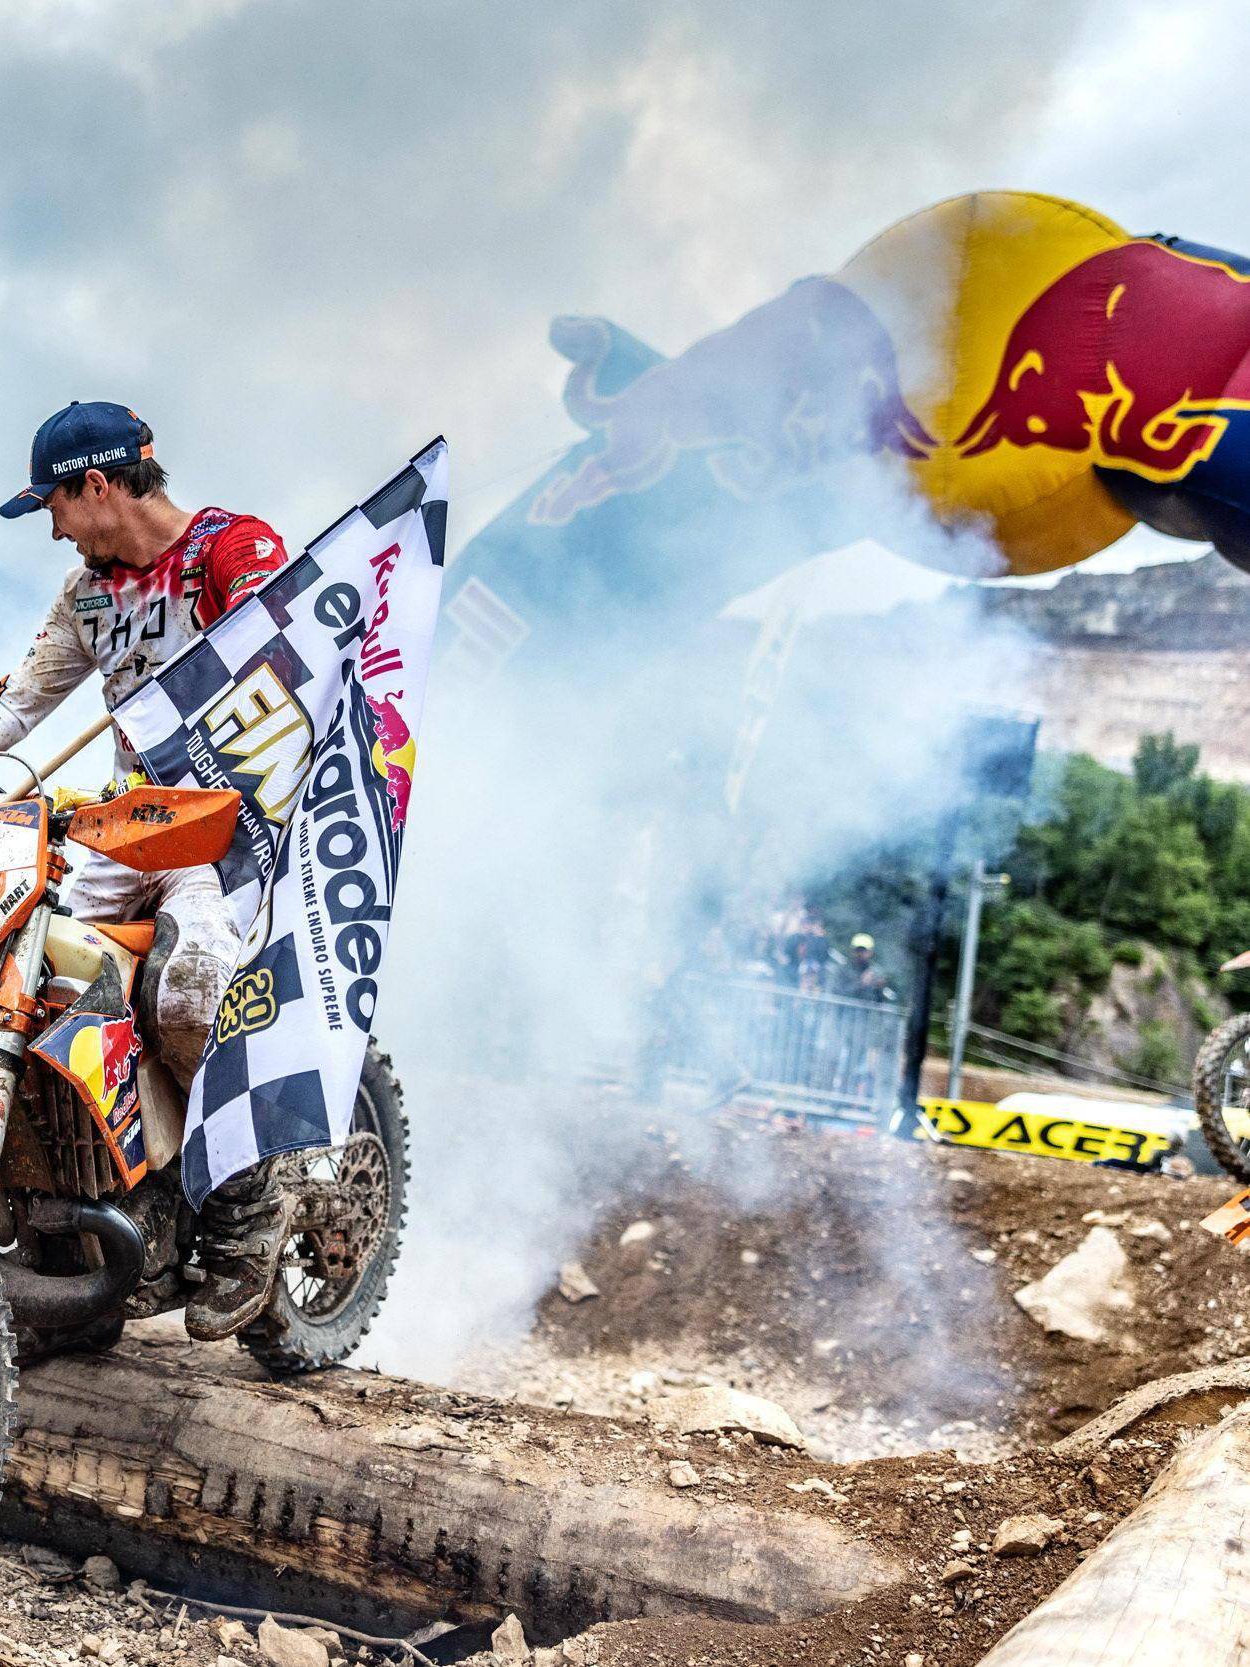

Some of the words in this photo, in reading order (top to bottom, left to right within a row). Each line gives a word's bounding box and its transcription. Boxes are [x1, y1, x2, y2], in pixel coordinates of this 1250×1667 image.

[52, 455, 90, 476] FACTORY
[91, 446, 127, 466] RACING
[76, 596, 109, 611] MOTOREX
[184, 728, 232, 791] TOUGHE
[237, 805, 263, 840] THAN
[130, 802, 177, 825] KTM
[299, 816, 310, 858] WORLD
[0, 878, 29, 916] HART
[301, 860, 317, 908] XTREME
[307, 911, 329, 963] ENDURO
[318, 968, 343, 1031] SUPREME
